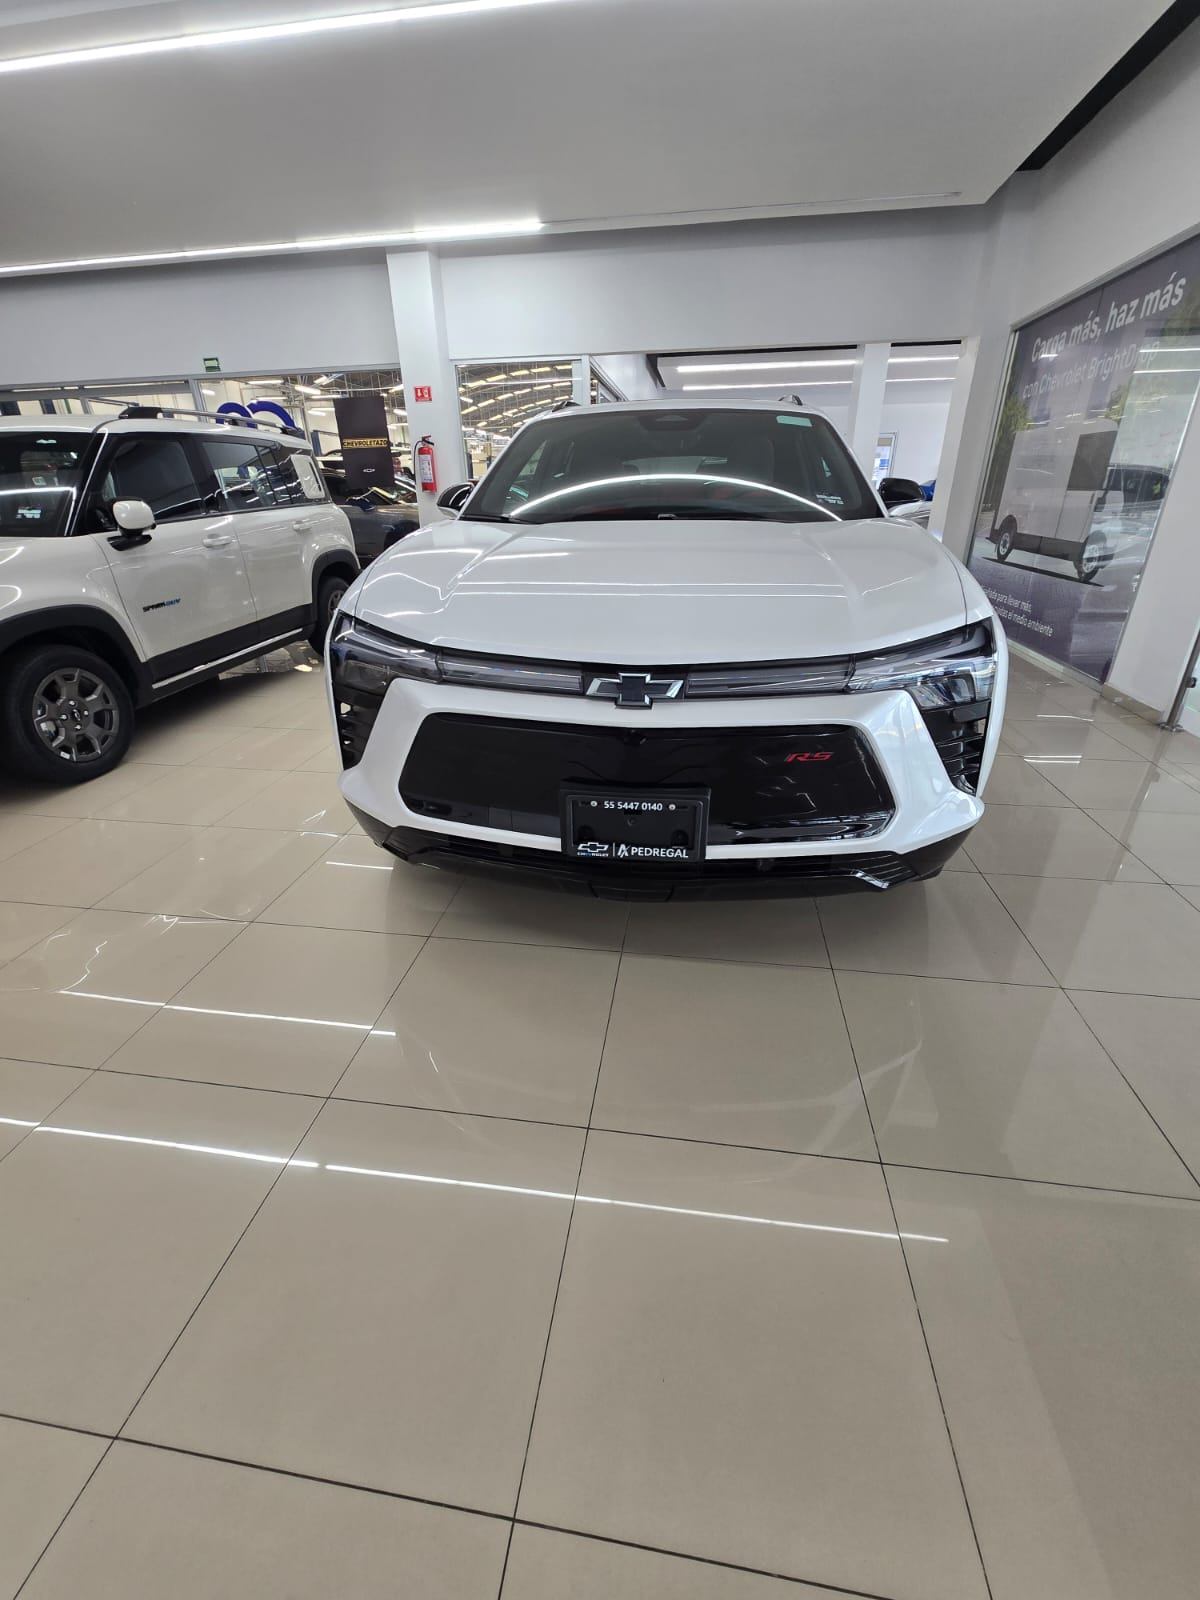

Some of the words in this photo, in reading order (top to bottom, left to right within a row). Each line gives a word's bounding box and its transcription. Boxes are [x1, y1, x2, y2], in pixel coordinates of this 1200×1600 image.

[1031, 330, 1068, 363] Carga
[1069, 310, 1101, 347] más,
[1105, 301, 1139, 333] haz
[1140, 271, 1187, 319] más
[783, 751, 834, 763] RS
[604, 800, 615, 809] 55
[617, 802, 639, 811] 5447
[641, 803, 663, 811] 0140
[631, 846, 689, 858] PEDREGAL
